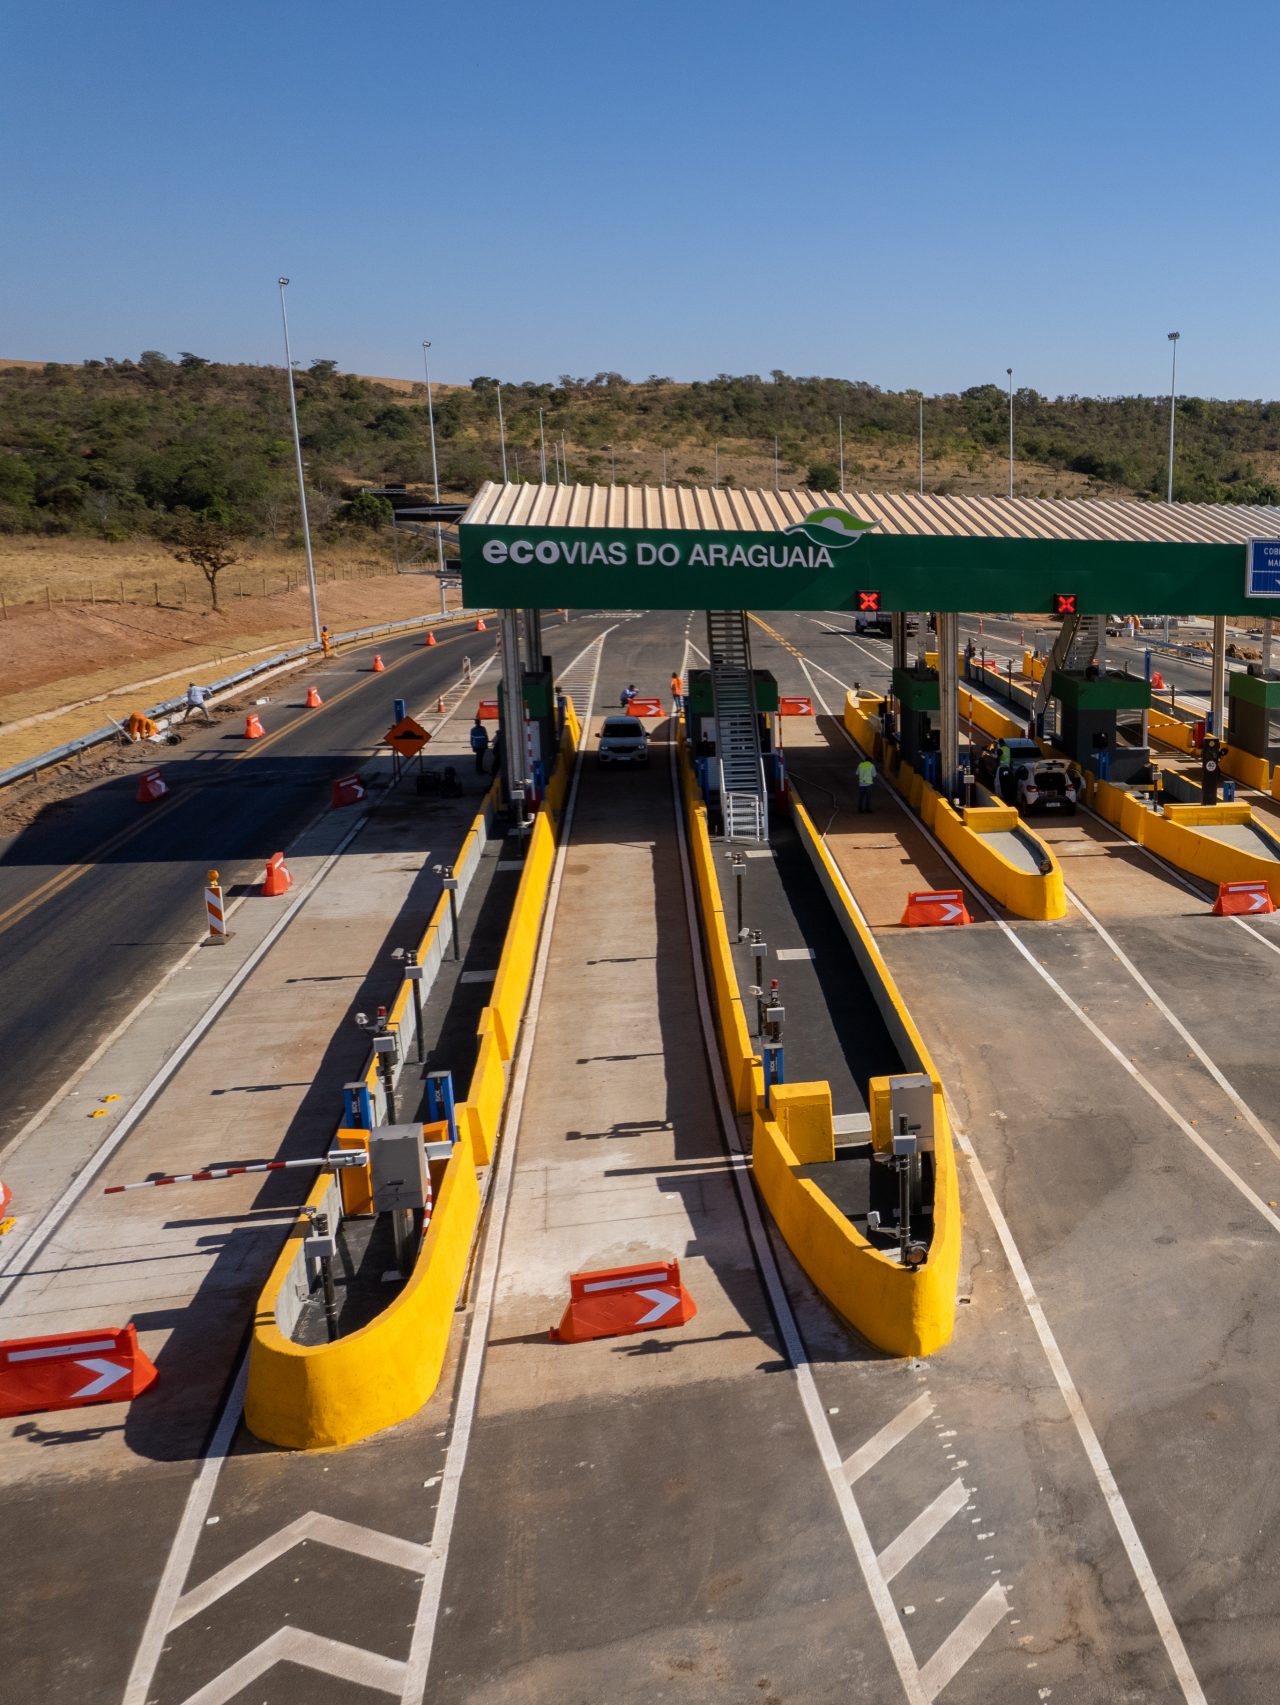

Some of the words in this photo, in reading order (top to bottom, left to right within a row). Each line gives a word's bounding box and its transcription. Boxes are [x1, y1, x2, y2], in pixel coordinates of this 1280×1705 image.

[482, 539, 627, 566] ecoVIAS
[637, 542, 680, 567] DO
[688, 543, 835, 569] ARAGUAIA
